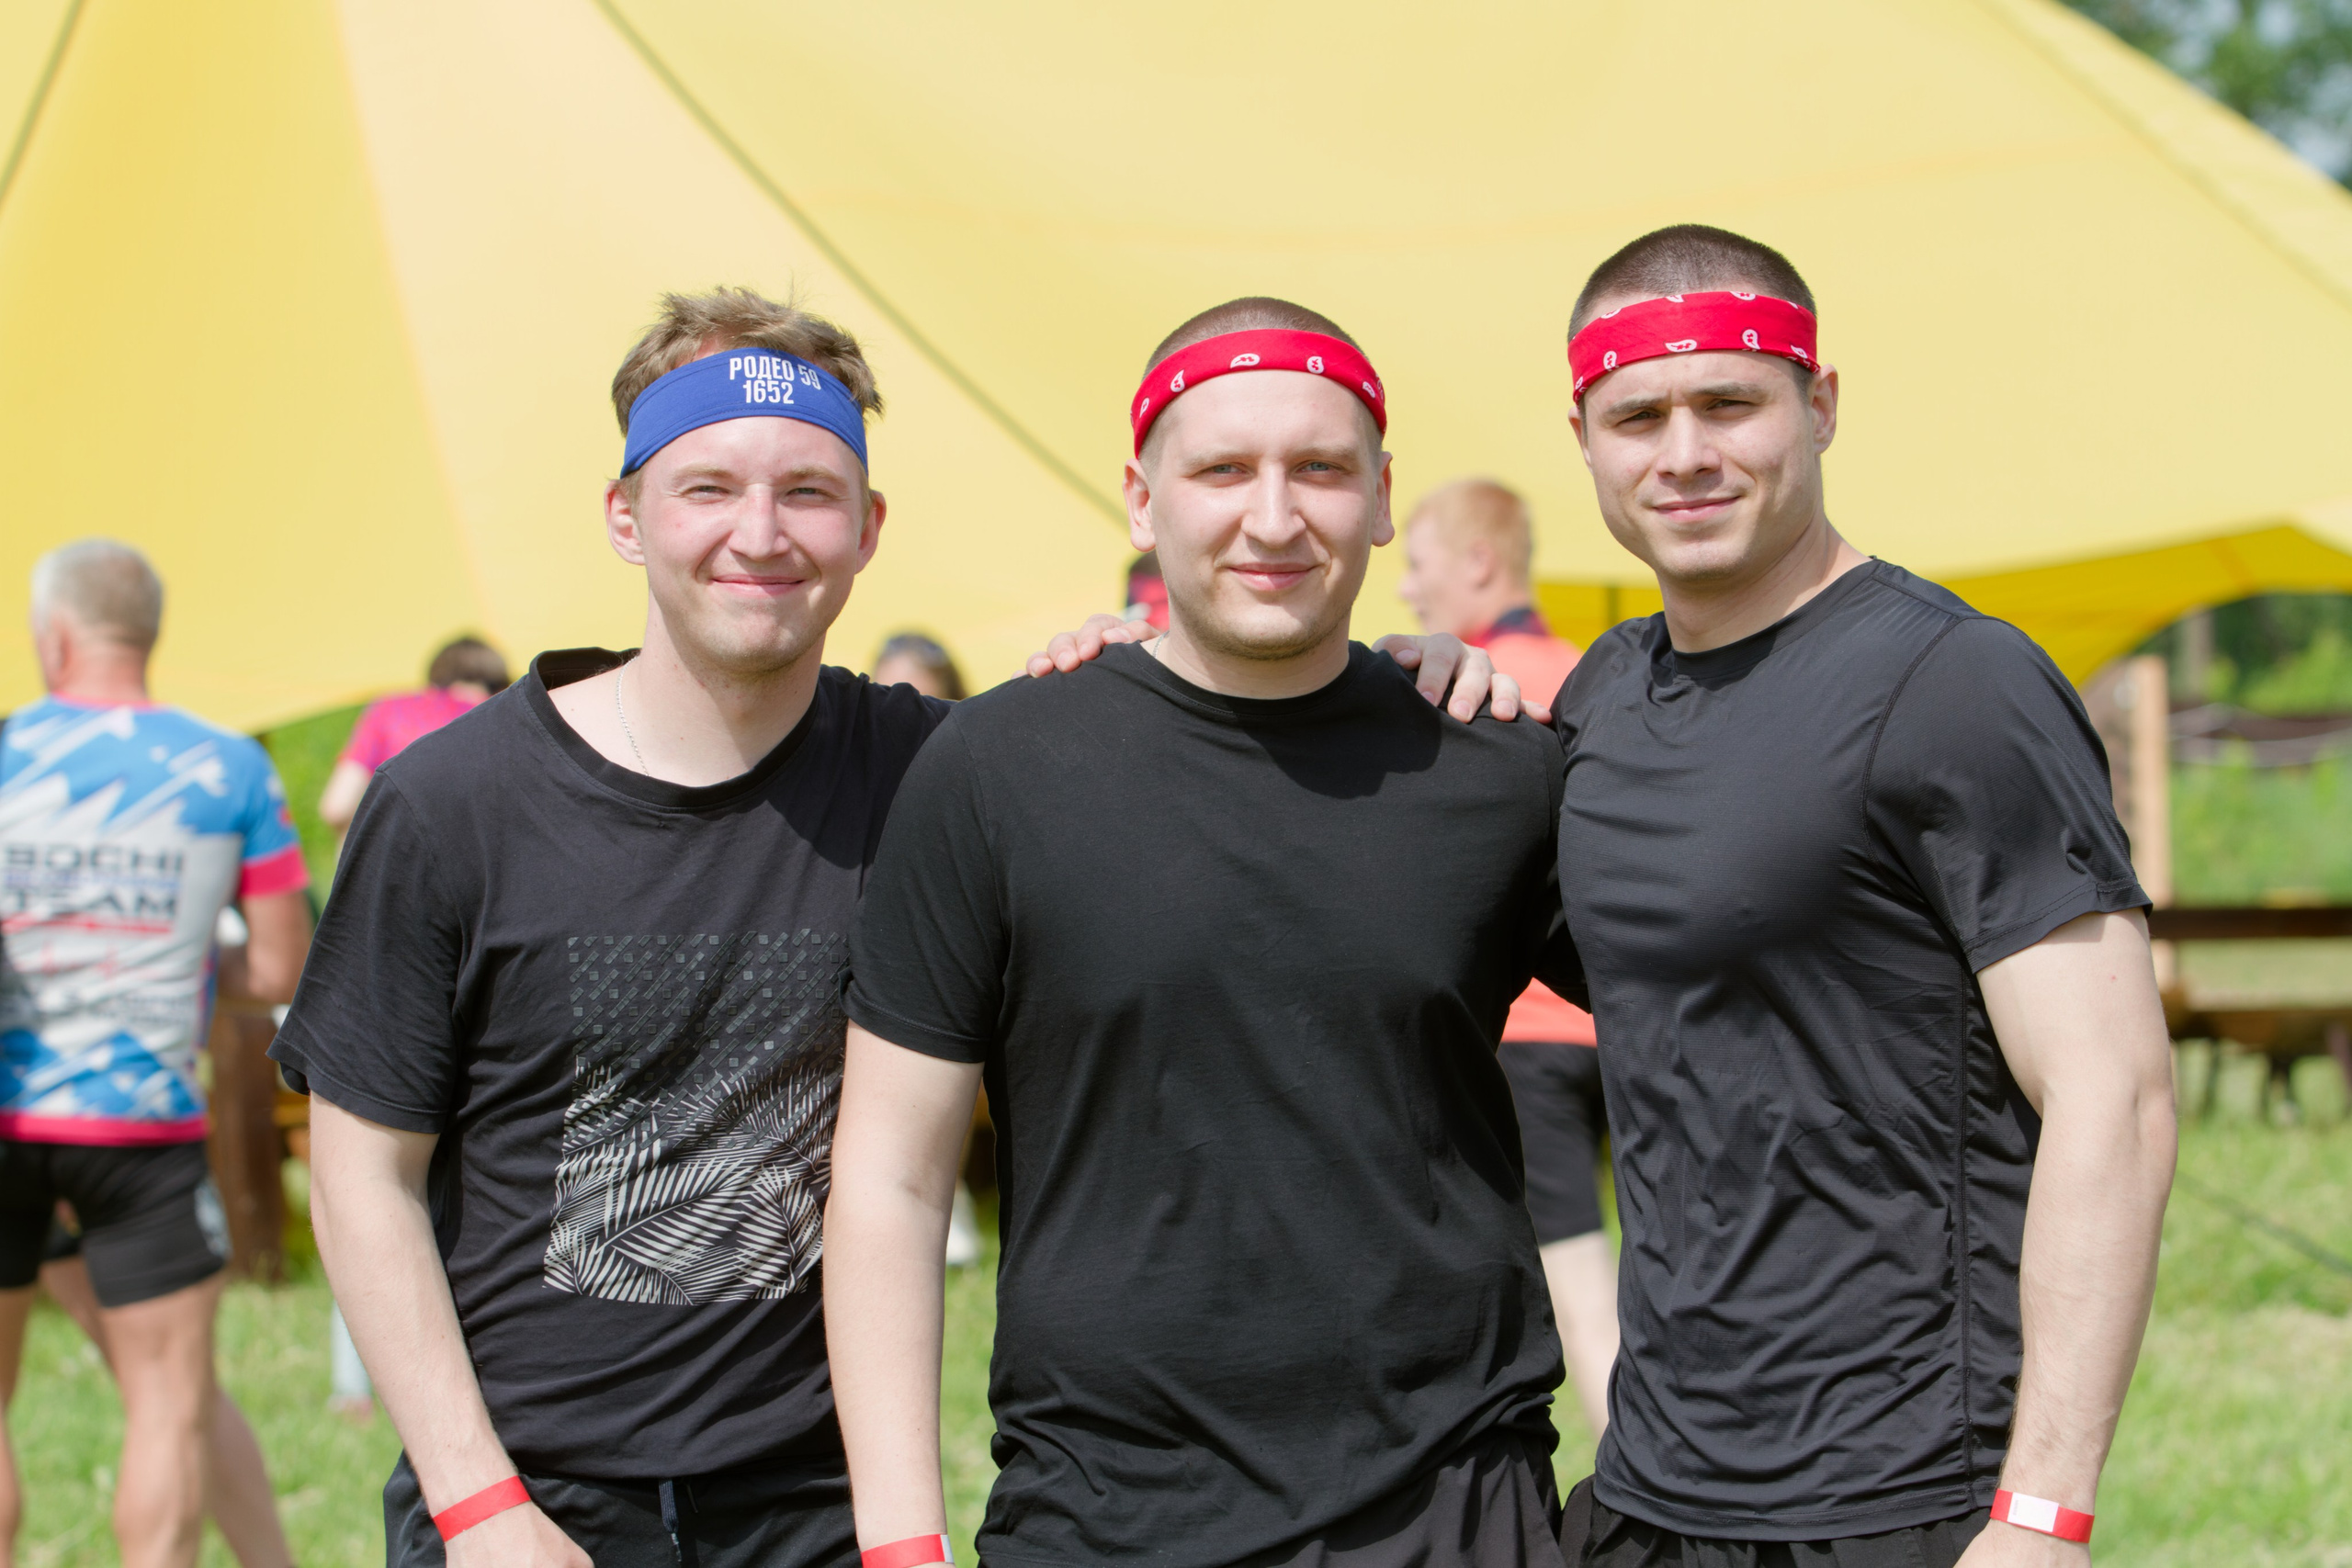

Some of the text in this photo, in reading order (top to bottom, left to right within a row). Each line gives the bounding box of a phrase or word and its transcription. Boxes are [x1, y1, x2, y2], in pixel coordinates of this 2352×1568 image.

[729, 355, 821, 390] РОДЕО 59
[742, 379, 795, 404] 1652
